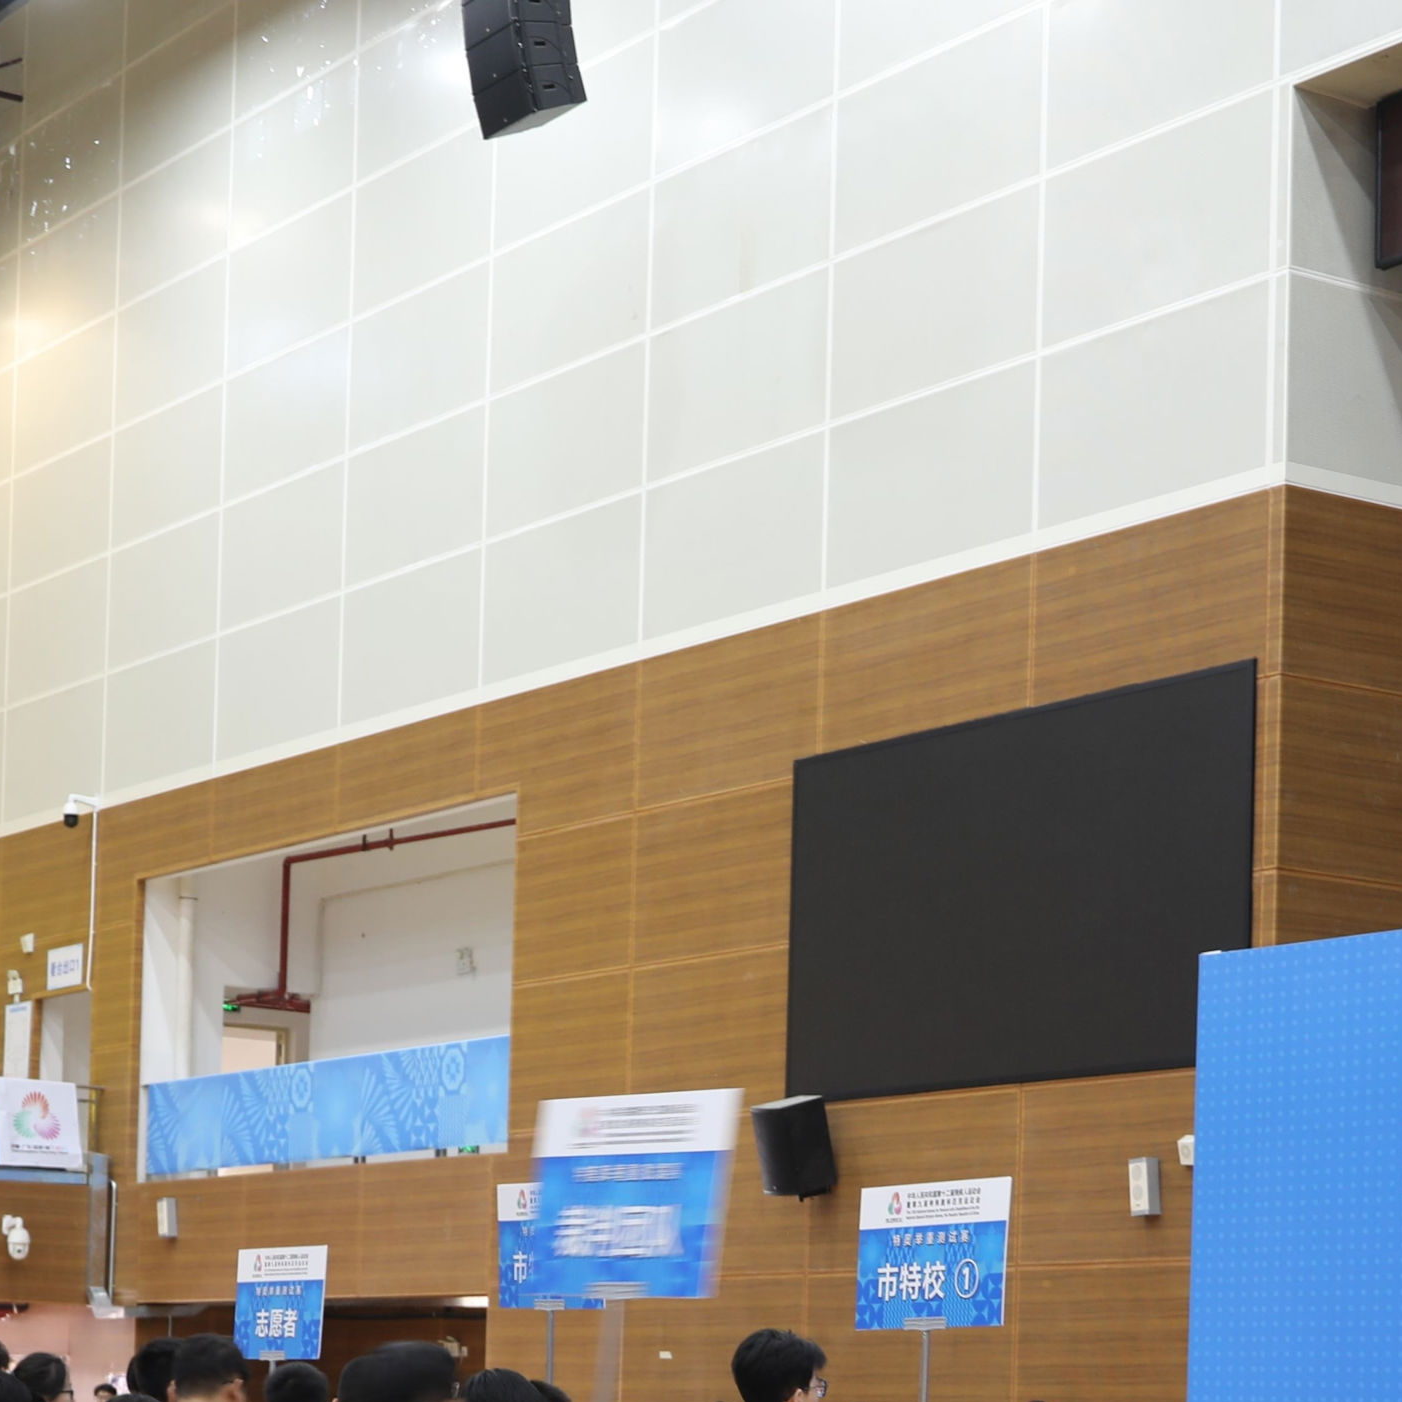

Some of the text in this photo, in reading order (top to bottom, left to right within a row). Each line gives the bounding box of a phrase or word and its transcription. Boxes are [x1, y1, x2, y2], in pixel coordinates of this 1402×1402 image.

[876, 1260, 947, 1302] 市特校
[254, 1307, 298, 1338] 志愿者
